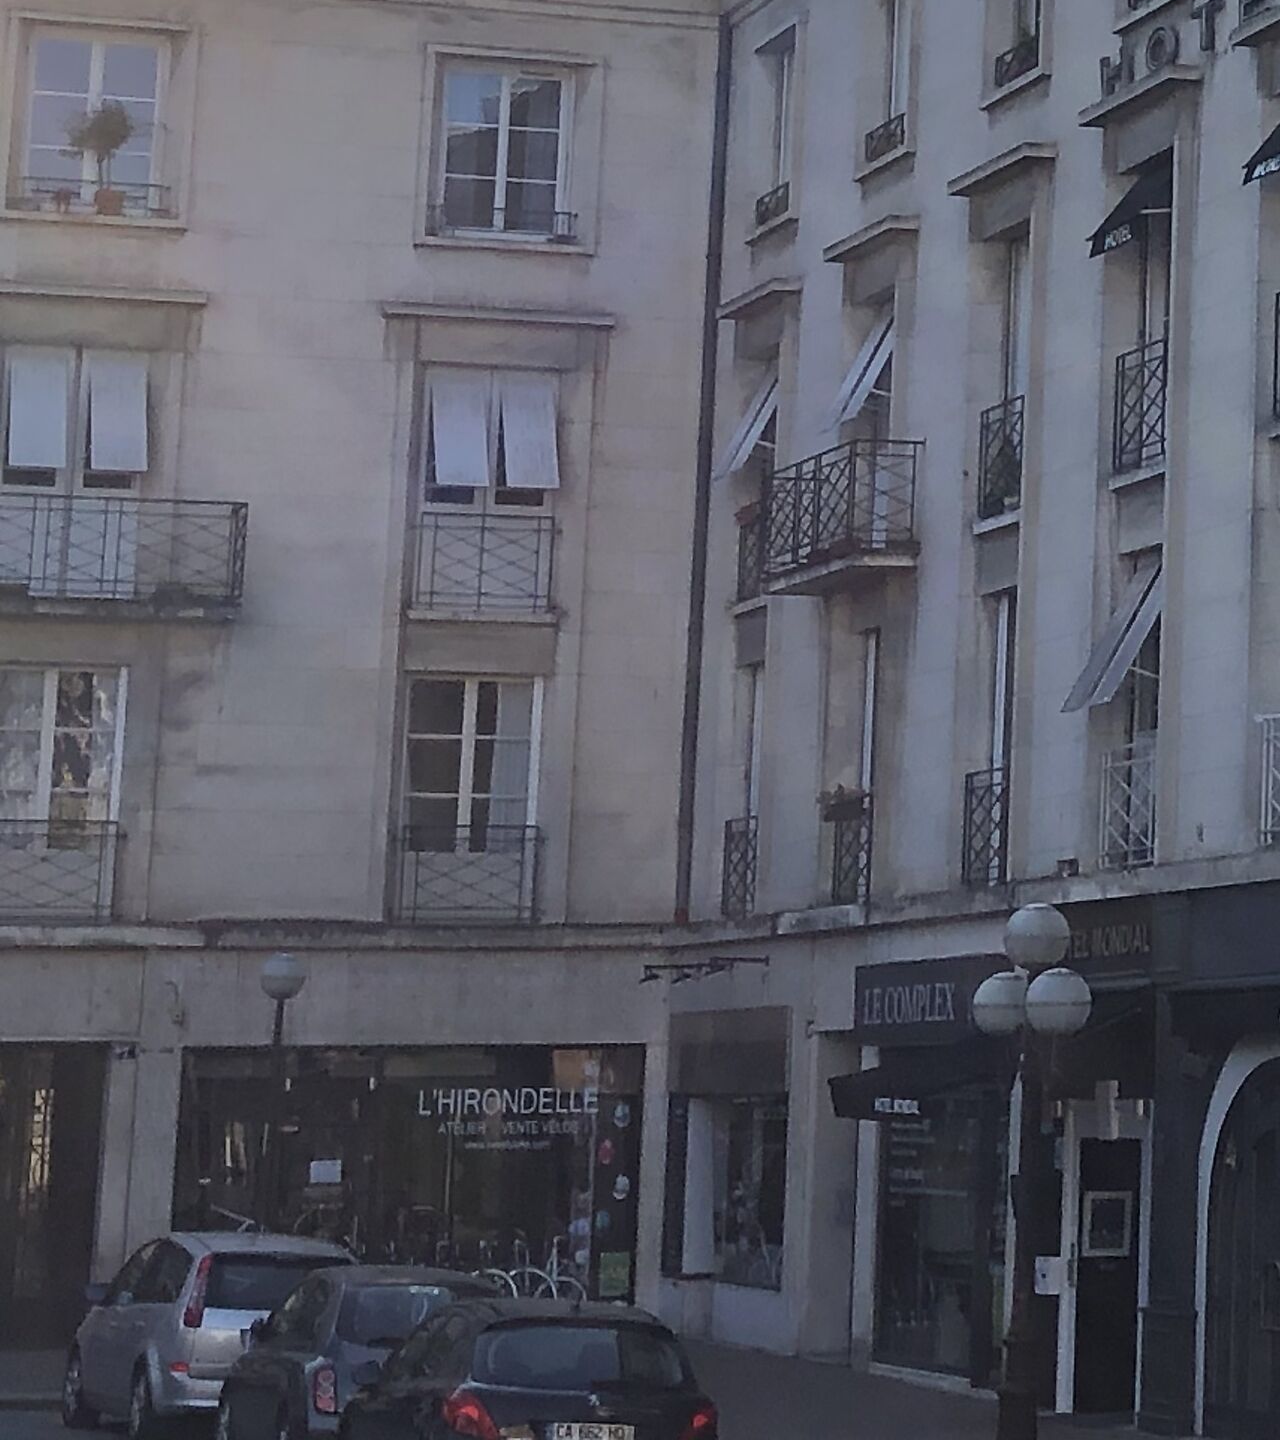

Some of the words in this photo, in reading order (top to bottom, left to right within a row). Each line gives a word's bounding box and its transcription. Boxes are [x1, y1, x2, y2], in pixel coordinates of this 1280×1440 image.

[863, 986, 882, 1025] LE
[884, 982, 956, 1024] COMPLEX
[418, 1086, 599, 1116] L'HIRONDELLE
